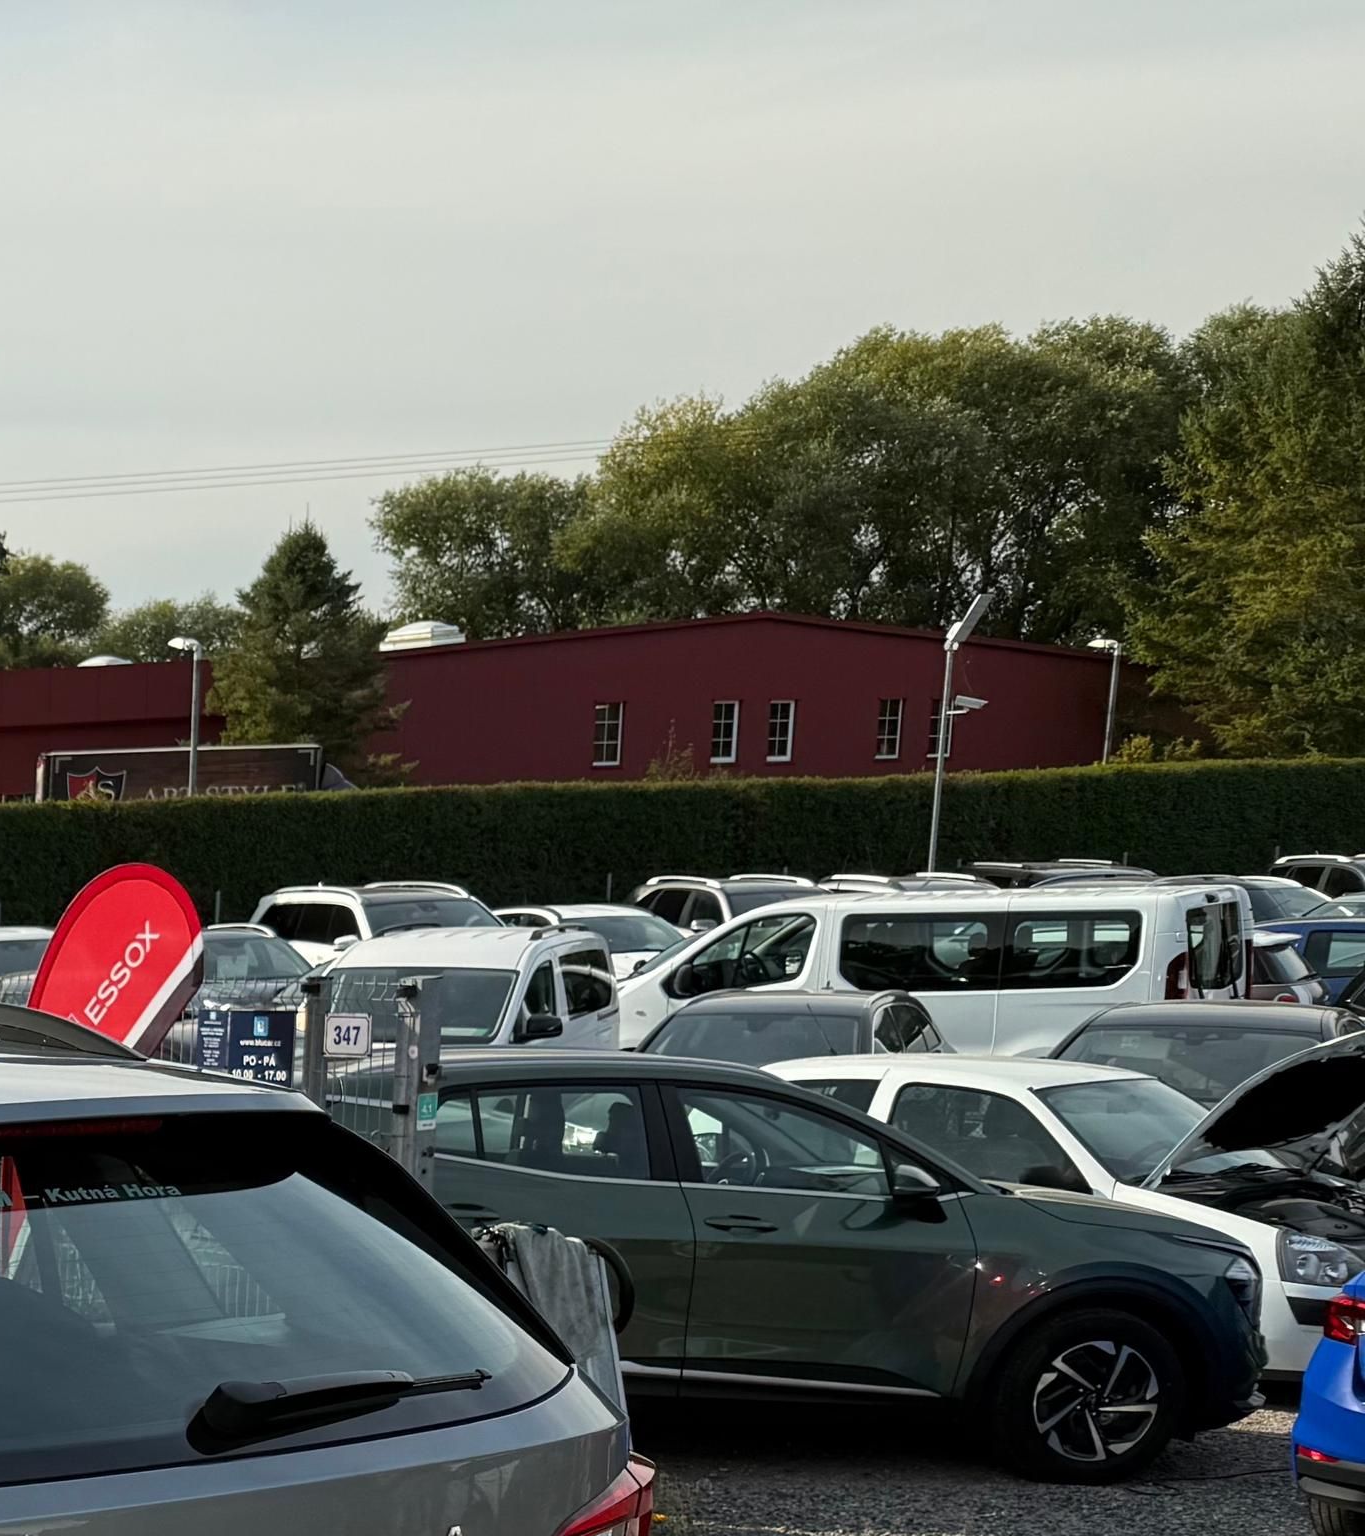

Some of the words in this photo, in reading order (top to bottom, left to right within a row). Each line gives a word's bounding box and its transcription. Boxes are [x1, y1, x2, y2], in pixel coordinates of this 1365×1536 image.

[84, 920, 161, 1026] ESSOX
[333, 1025, 361, 1046] 347
[243, 1055, 256, 1066] PO
[263, 1053, 276, 1067] PÁ
[232, 1068, 254, 1080] 1000
[264, 1070, 287, 1082] 17.00
[44, 1184, 119, 1203] Kutná
[122, 1183, 182, 1198] Hora
